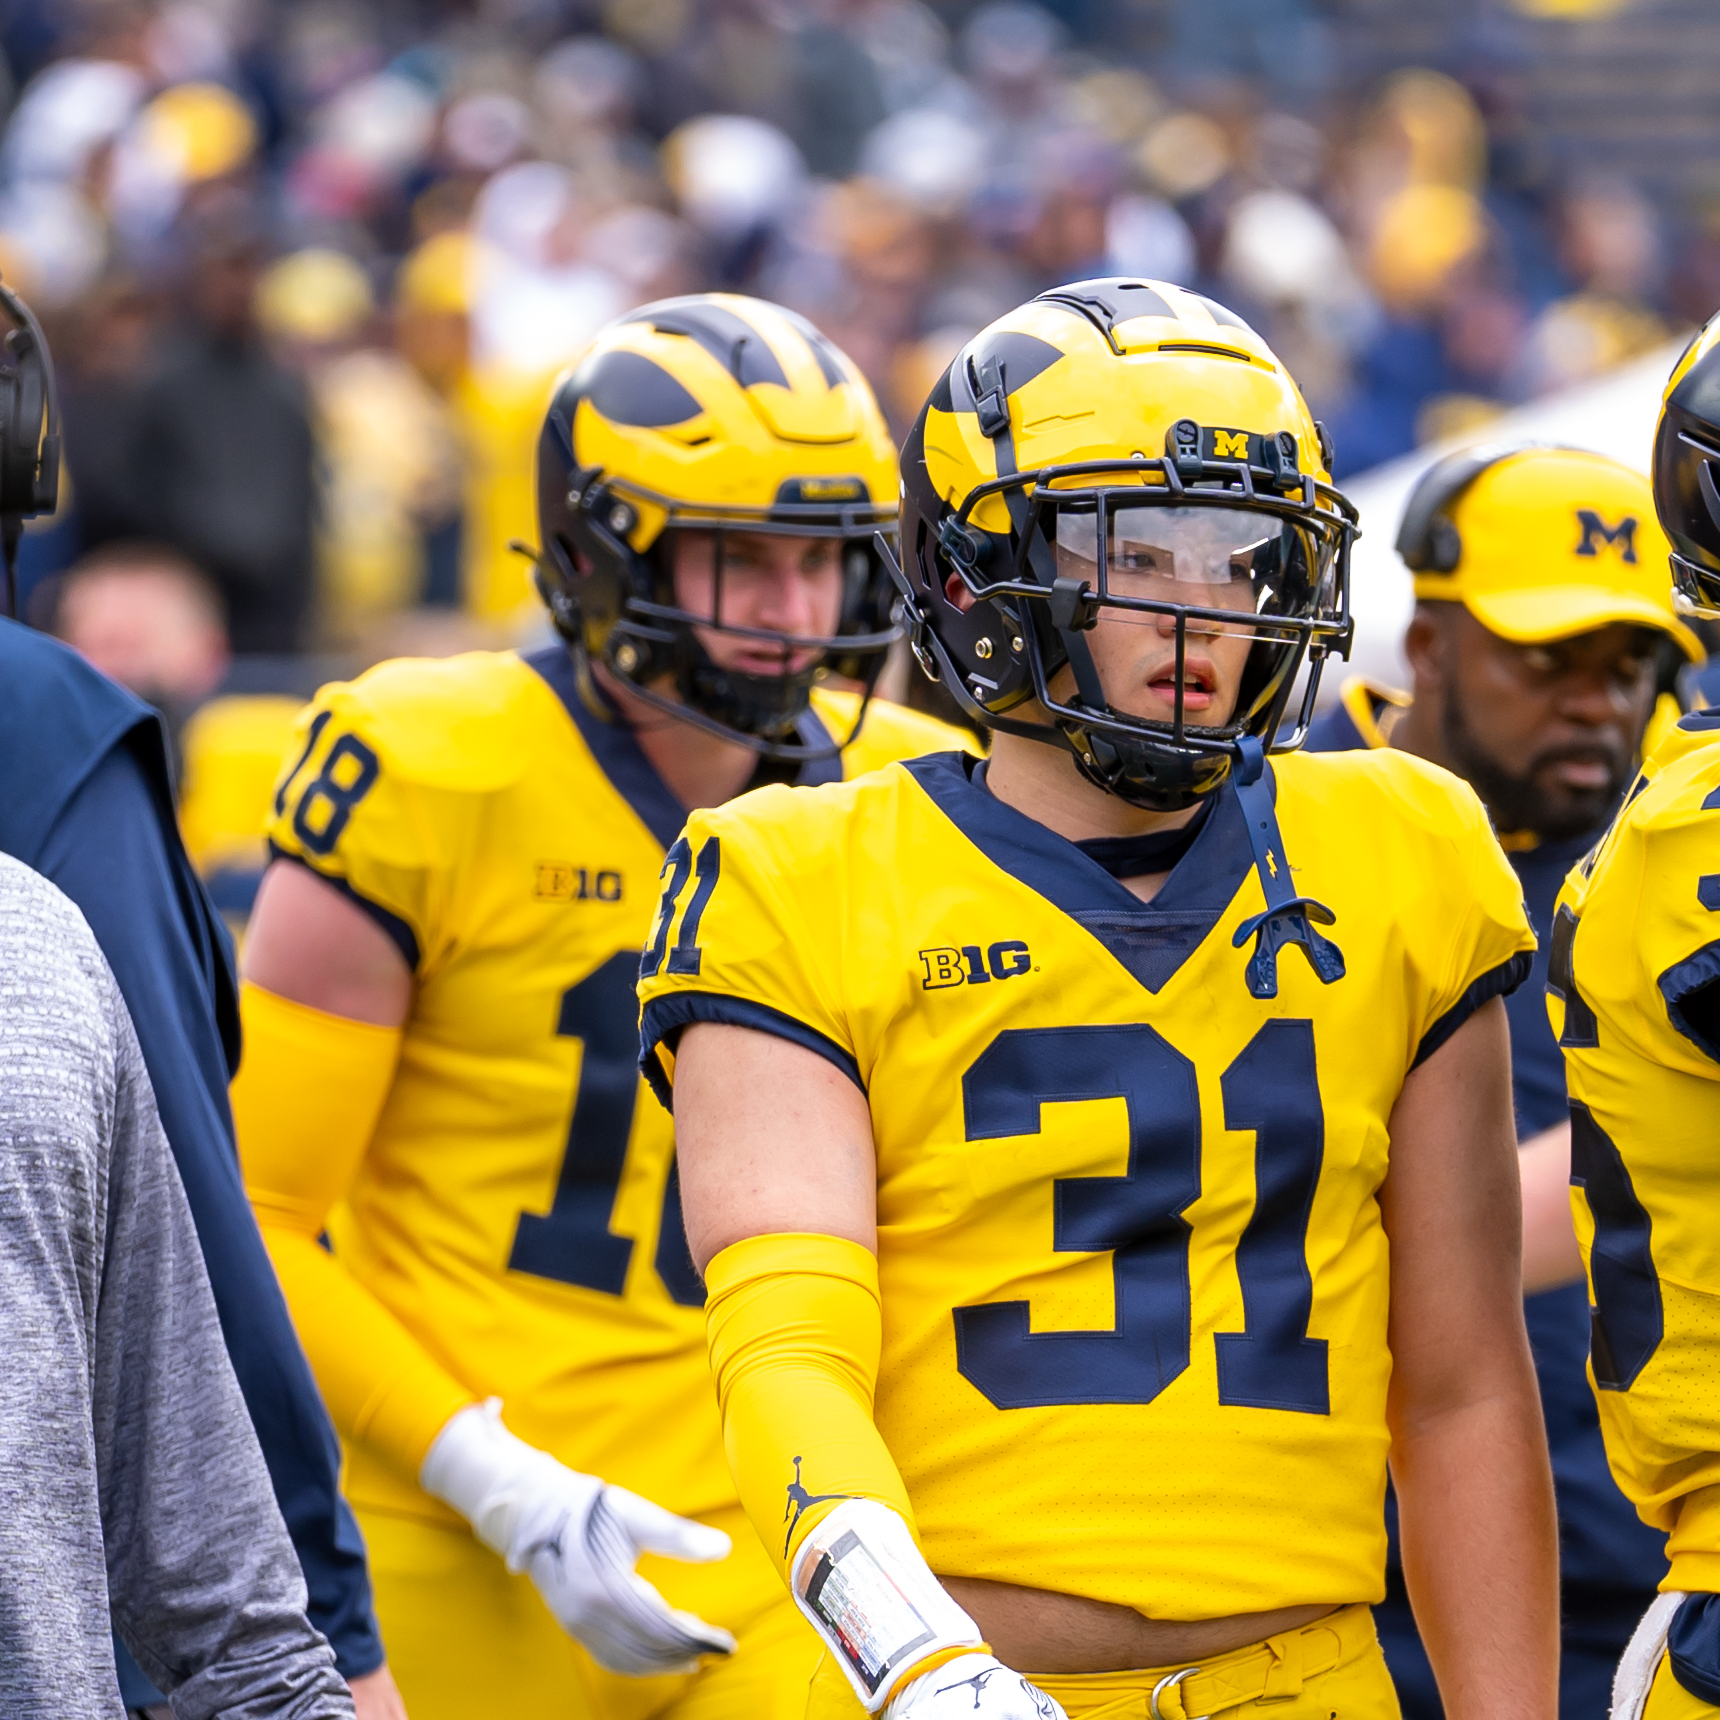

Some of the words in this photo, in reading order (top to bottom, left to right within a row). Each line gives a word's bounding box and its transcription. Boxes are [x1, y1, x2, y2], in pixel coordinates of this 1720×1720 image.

[1213, 429, 1249, 459] M
[1576, 508, 1638, 565] M
[276, 710, 380, 855] 18
[639, 836, 721, 979] 31
[951, 1017, 1330, 1416] 31
